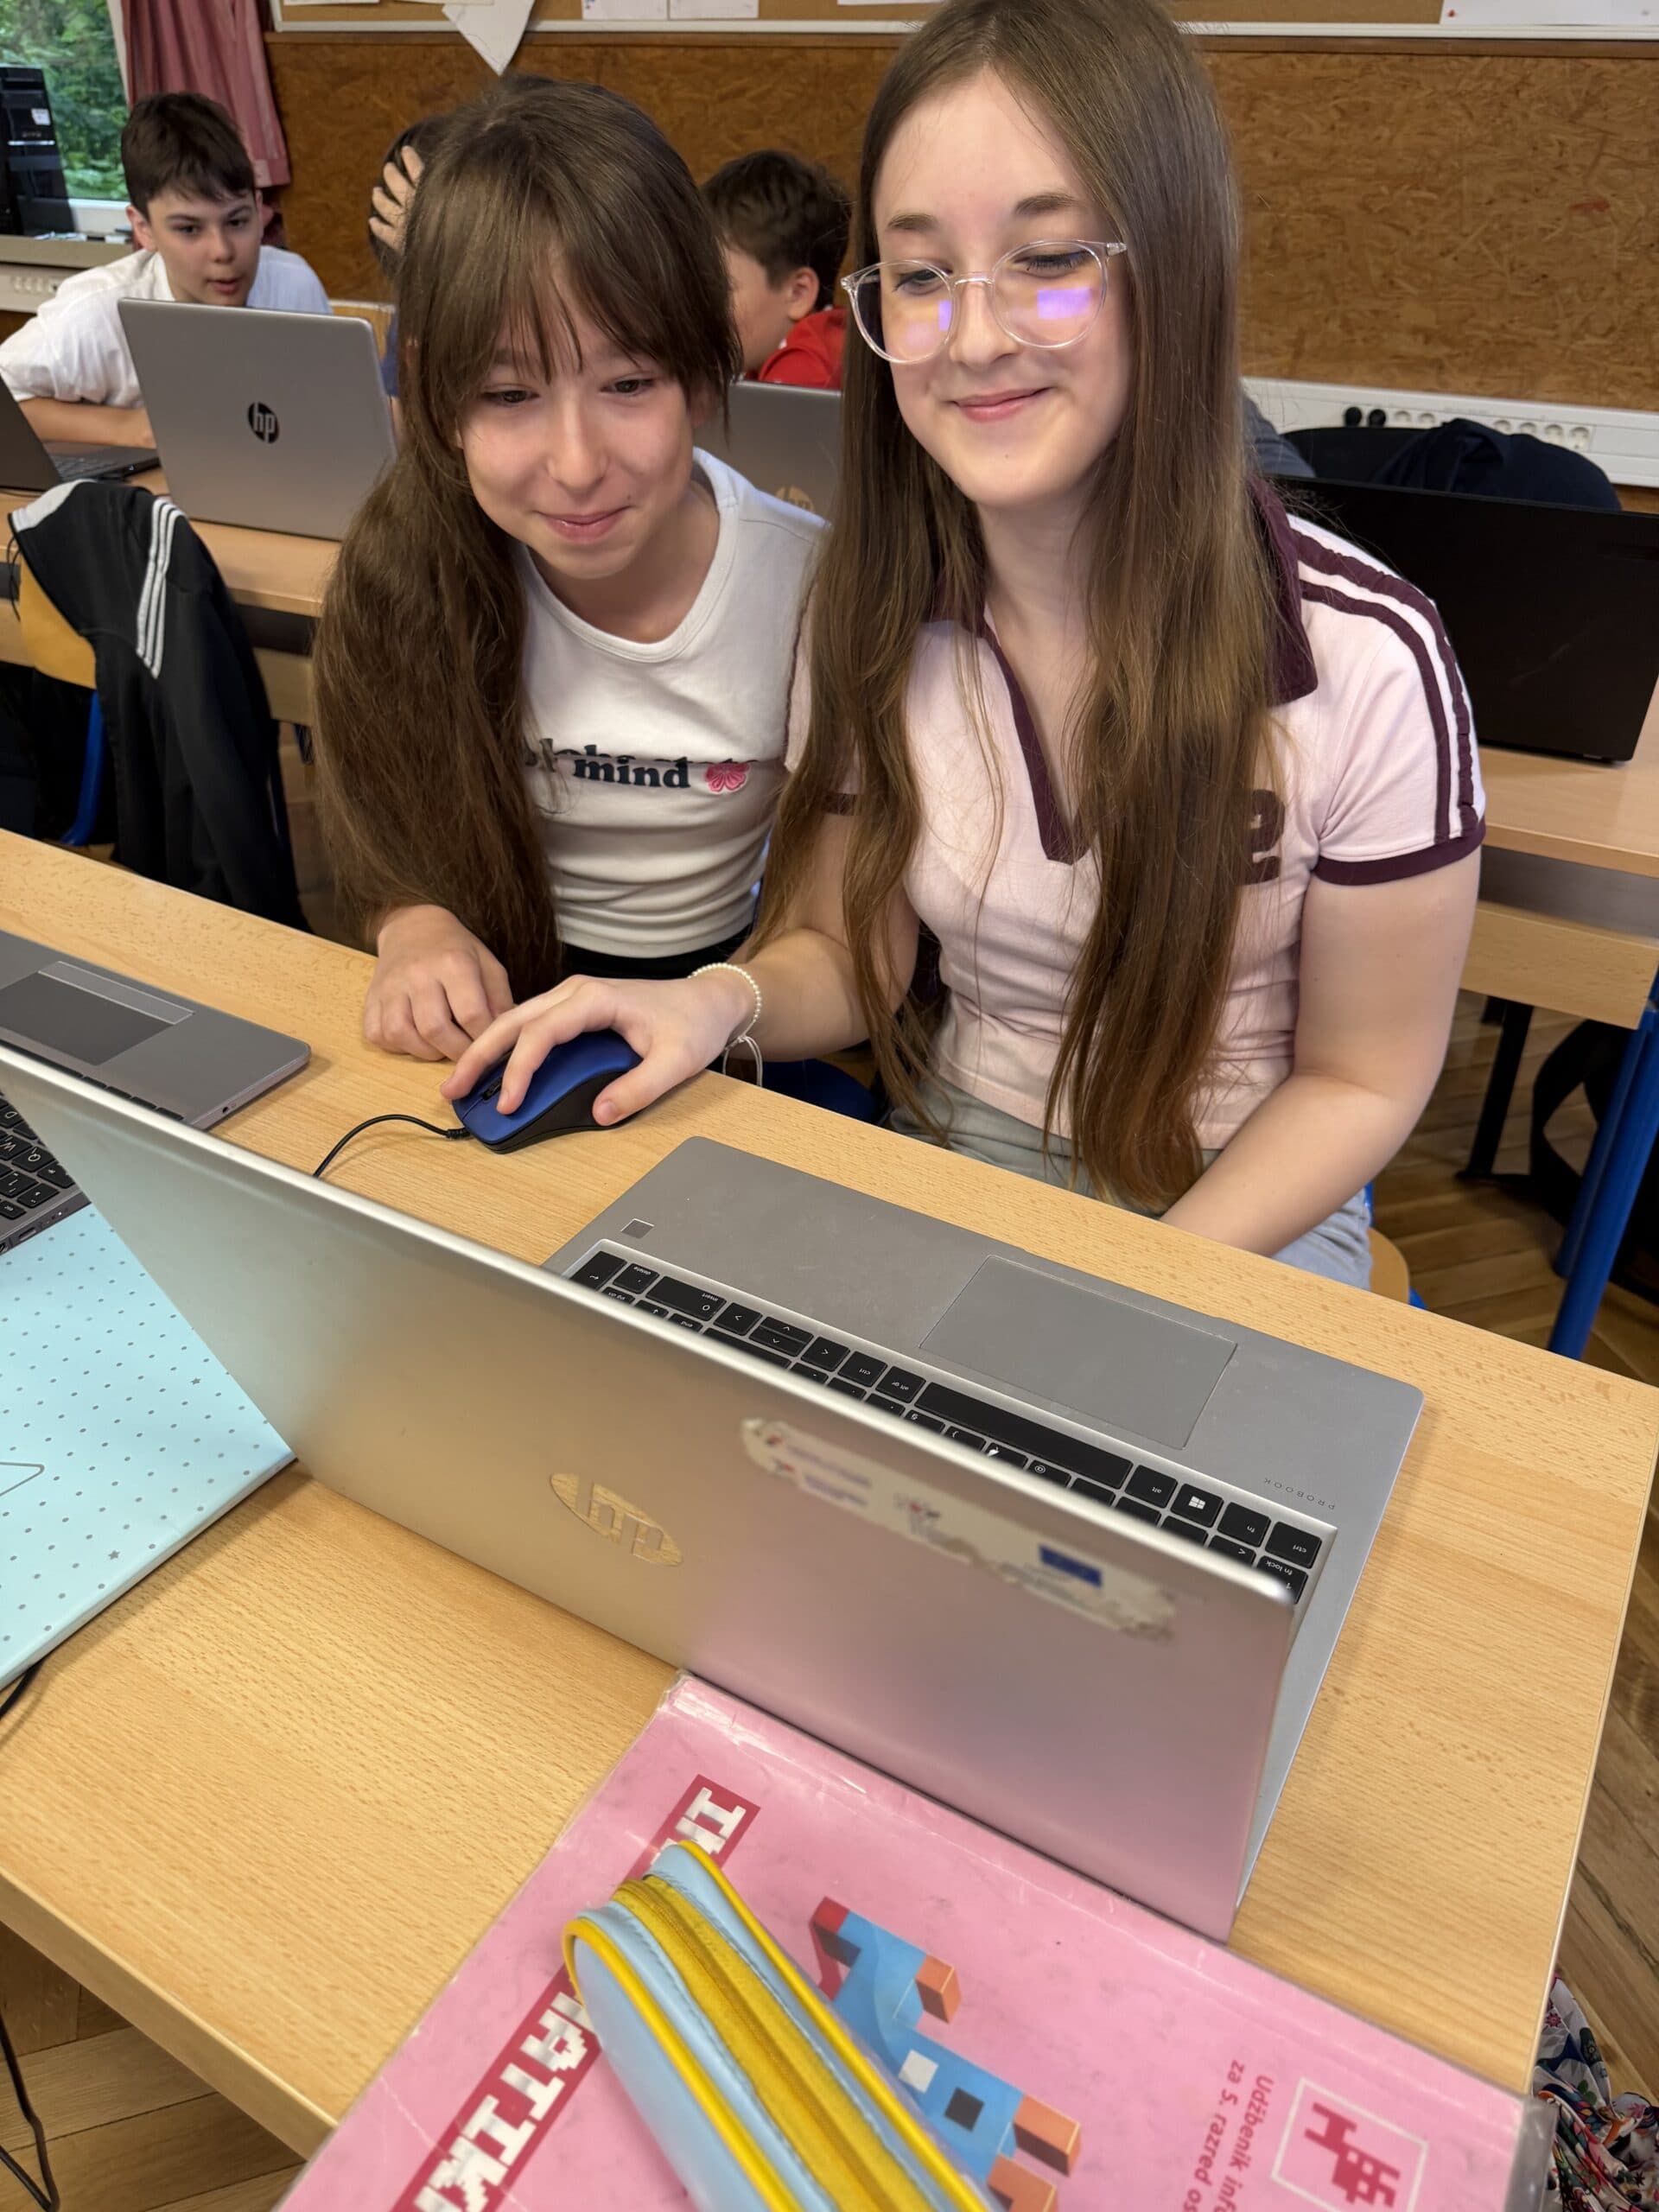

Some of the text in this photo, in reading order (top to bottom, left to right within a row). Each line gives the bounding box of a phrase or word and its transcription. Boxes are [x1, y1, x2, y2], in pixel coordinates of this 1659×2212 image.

[250, 402, 277, 443] hp
[572, 755, 691, 789] mind
[1263, 1477, 1336, 1510] PROBOOK
[1293, 1543, 1307, 1554] ctrl
[1265, 1559, 1283, 1573] lock
[1228, 2060, 1245, 2083] za
[1219, 2088, 1238, 2106] 5.
[1229, 2075, 1274, 2171] Udžbenik
[1194, 2113, 1227, 2186] razred
